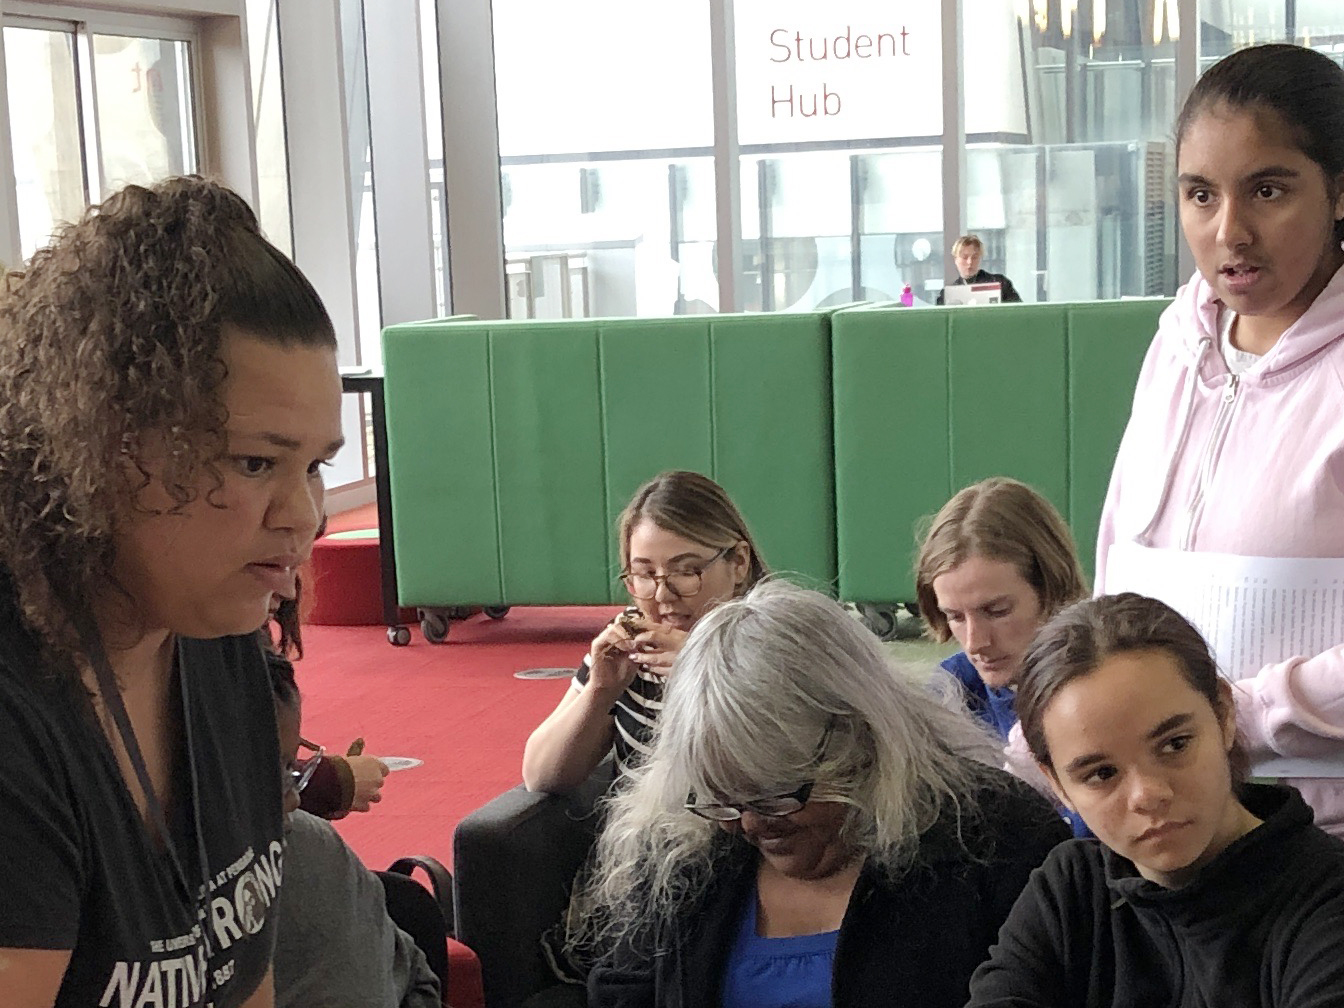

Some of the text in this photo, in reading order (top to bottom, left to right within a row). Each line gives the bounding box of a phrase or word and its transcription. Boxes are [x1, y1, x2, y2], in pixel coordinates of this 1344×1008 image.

[770, 25, 910, 62] Student
[771, 83, 841, 118] Hub
[199, 840, 284, 957] RONG
[212, 959, 235, 990] 887
